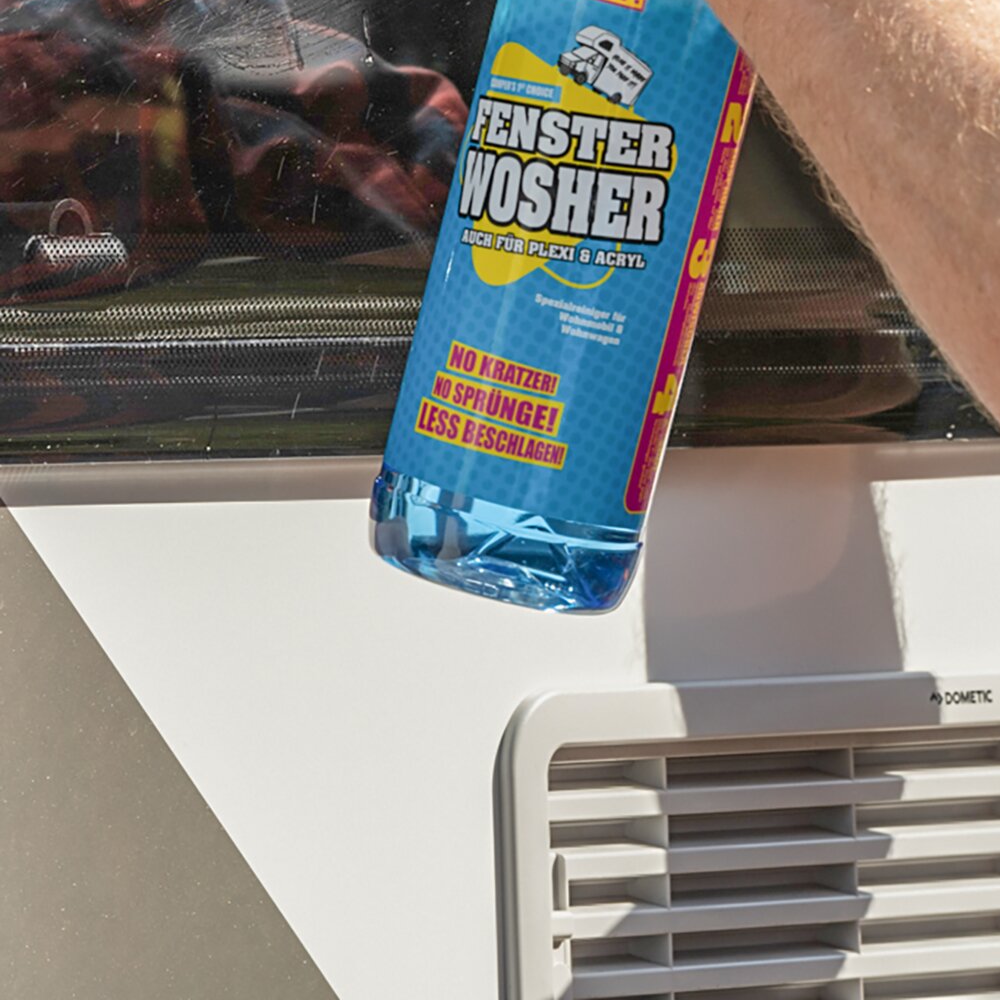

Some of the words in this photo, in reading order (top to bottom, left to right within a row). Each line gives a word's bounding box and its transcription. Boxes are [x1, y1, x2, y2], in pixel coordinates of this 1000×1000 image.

[470, 97, 674, 170] FENSTER
[459, 148, 667, 243] WOSHER
[461, 229, 492, 248] AUCH
[495, 233, 524, 254] FÜR
[528, 241, 574, 261] PLEXI
[579, 248, 592, 264] &
[594, 251, 646, 269] ACRYL
[449, 344, 477, 372] NO
[479, 355, 558, 394] KRATZER!
[433, 375, 452, 399] NO
[453, 383, 559, 433] SPRÜNGE!
[418, 402, 460, 439] LESS
[461, 419, 565, 465] BESCHLAGEN!
[945, 690, 992, 705] DOMETIC
